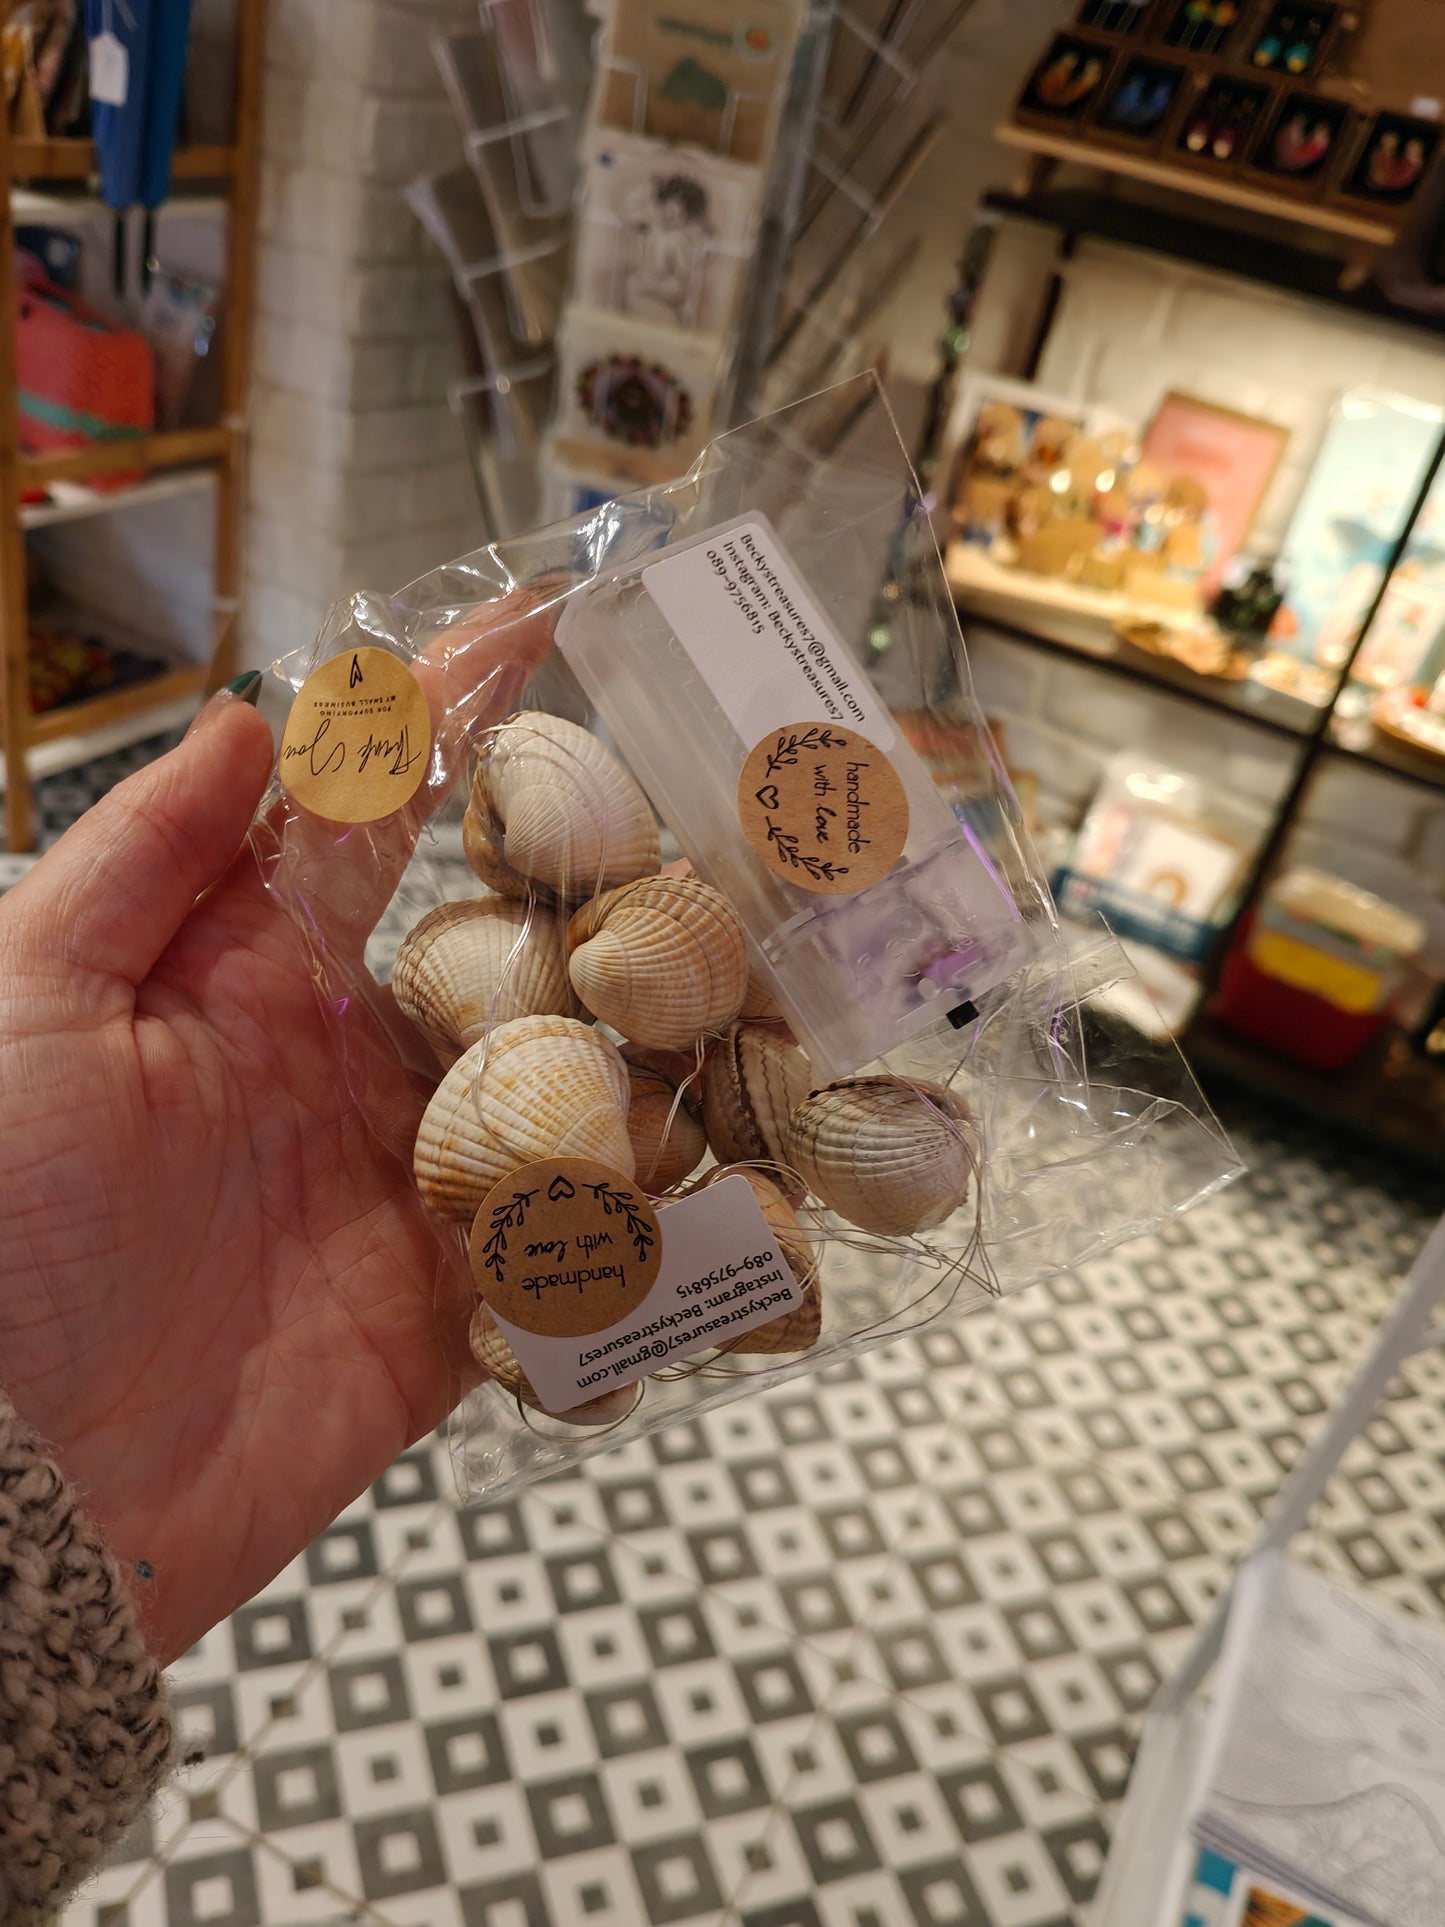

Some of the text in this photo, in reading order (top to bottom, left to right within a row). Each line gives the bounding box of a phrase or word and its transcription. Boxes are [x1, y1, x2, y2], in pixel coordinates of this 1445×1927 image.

[722, 540, 844, 721] Instagram: Beckystreasures7
[740, 533, 866, 722] Beckystreasures7@gmail.com
[313, 700, 356, 708] BUSINESS
[320, 708, 373, 717] SUPPORTING
[360, 698, 383, 706] SMALL
[283, 718, 422, 776] Thank You
[813, 764, 837, 844] with love
[846, 761, 871, 854] handmade
[521, 1264, 626, 1300] handmade
[523, 1232, 614, 1263] with love
[576, 1287, 793, 1389] Beckystreasures7@gmail.com
[578, 1269, 784, 1367] Instagram: Beckystreasures7
